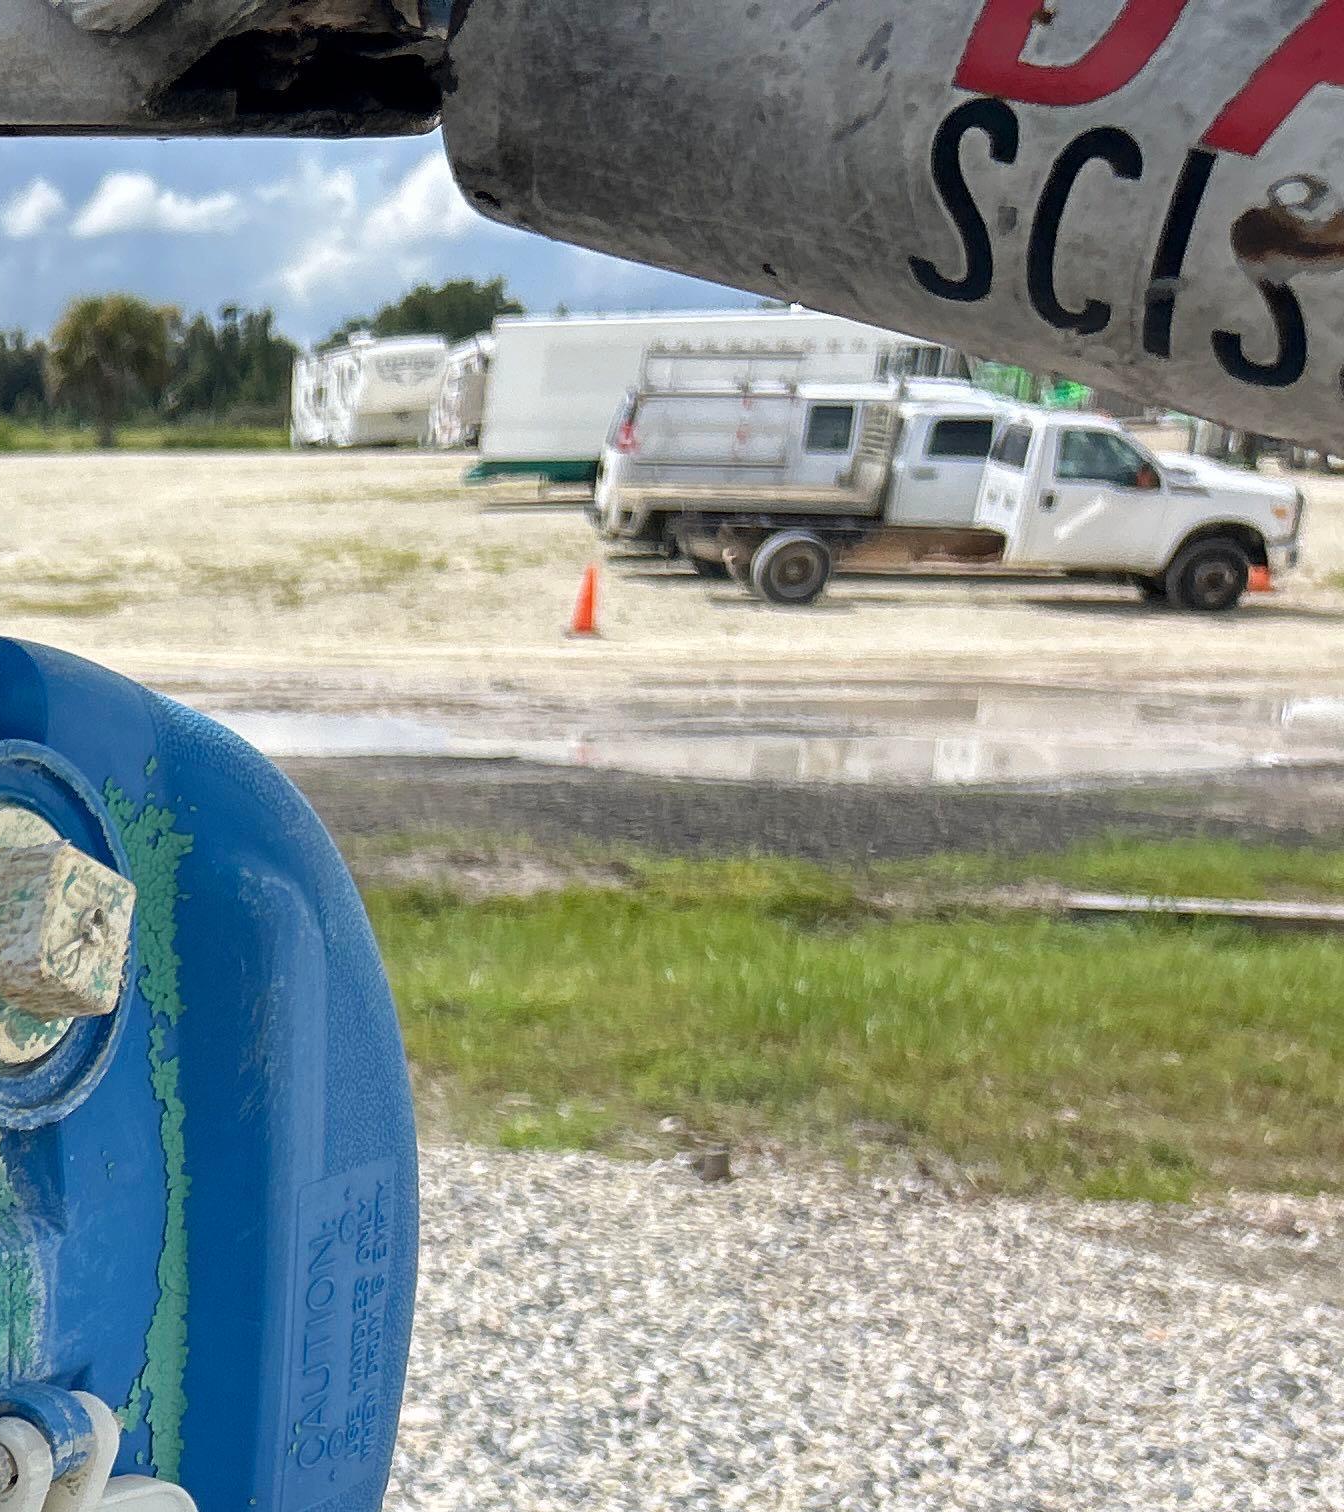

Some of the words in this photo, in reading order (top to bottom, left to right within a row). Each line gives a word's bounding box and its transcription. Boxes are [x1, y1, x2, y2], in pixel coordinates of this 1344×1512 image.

[355, 1198, 373, 1264] ONLY
[349, 1274, 370, 1397] HANDLES
[365, 1304, 384, 1379] DRUM
[344, 1404, 363, 1459] USE
[360, 1390, 379, 1462] WHEN
